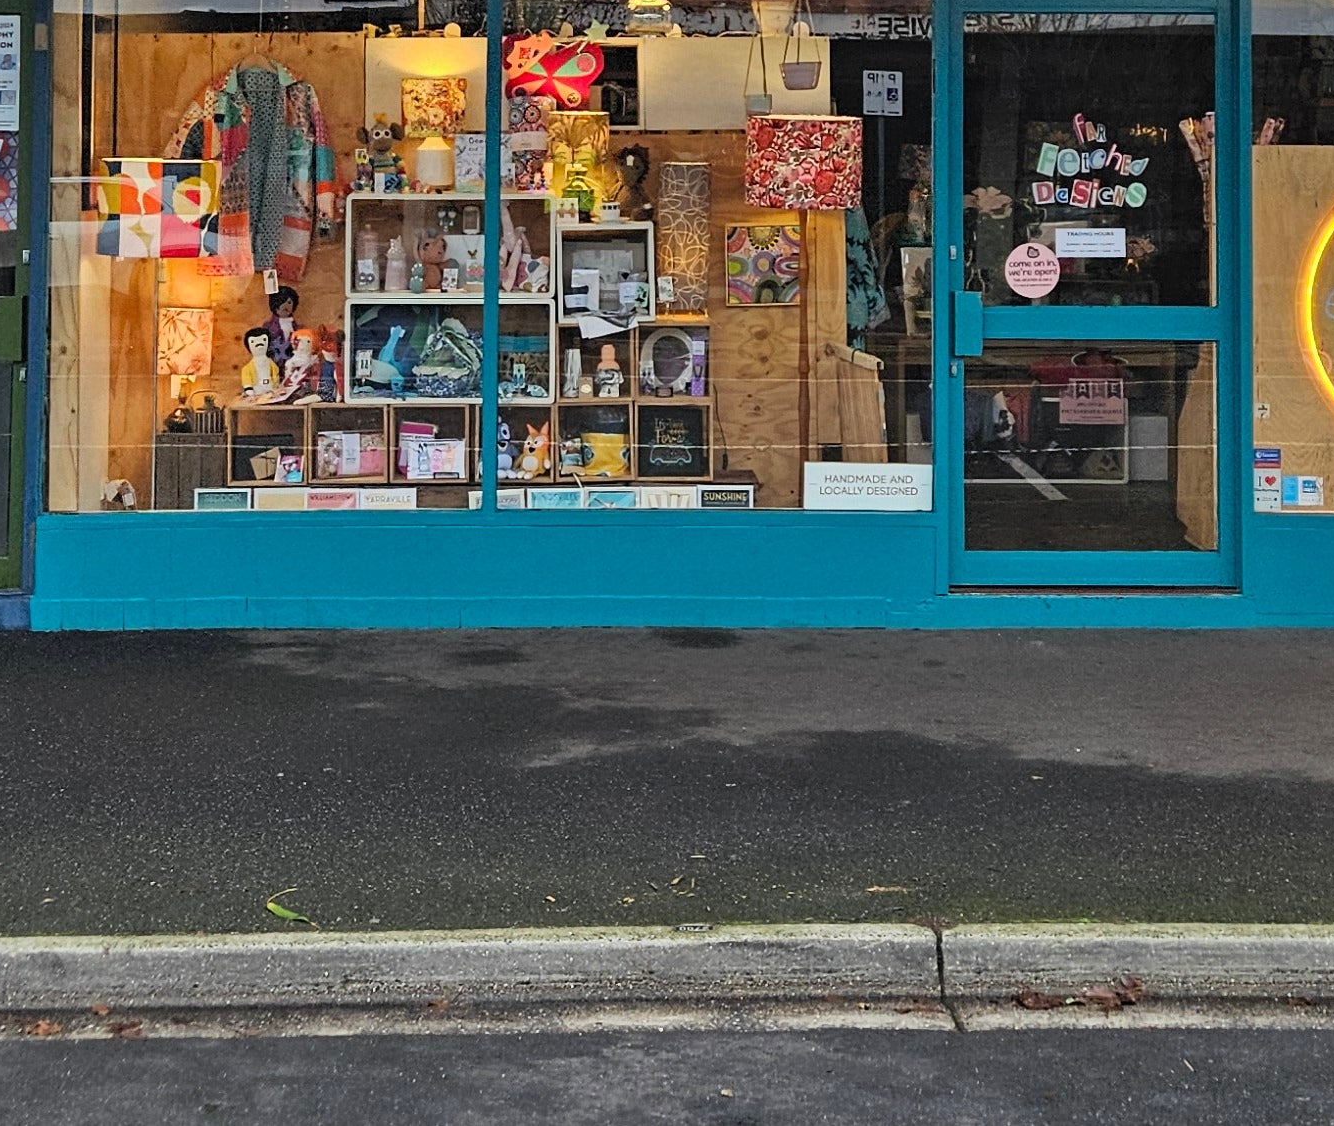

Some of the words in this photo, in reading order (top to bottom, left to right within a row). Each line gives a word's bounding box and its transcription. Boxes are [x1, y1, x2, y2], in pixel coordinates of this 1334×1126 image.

[1008, 260, 1032, 268] come
[824, 474, 887, 484] HANDMADE
[890, 475, 914, 484] AND
[819, 486, 864, 495] LOCALLY
[866, 486, 919, 496] DESIGNED
[703, 491, 748, 502] SUNSHINE
